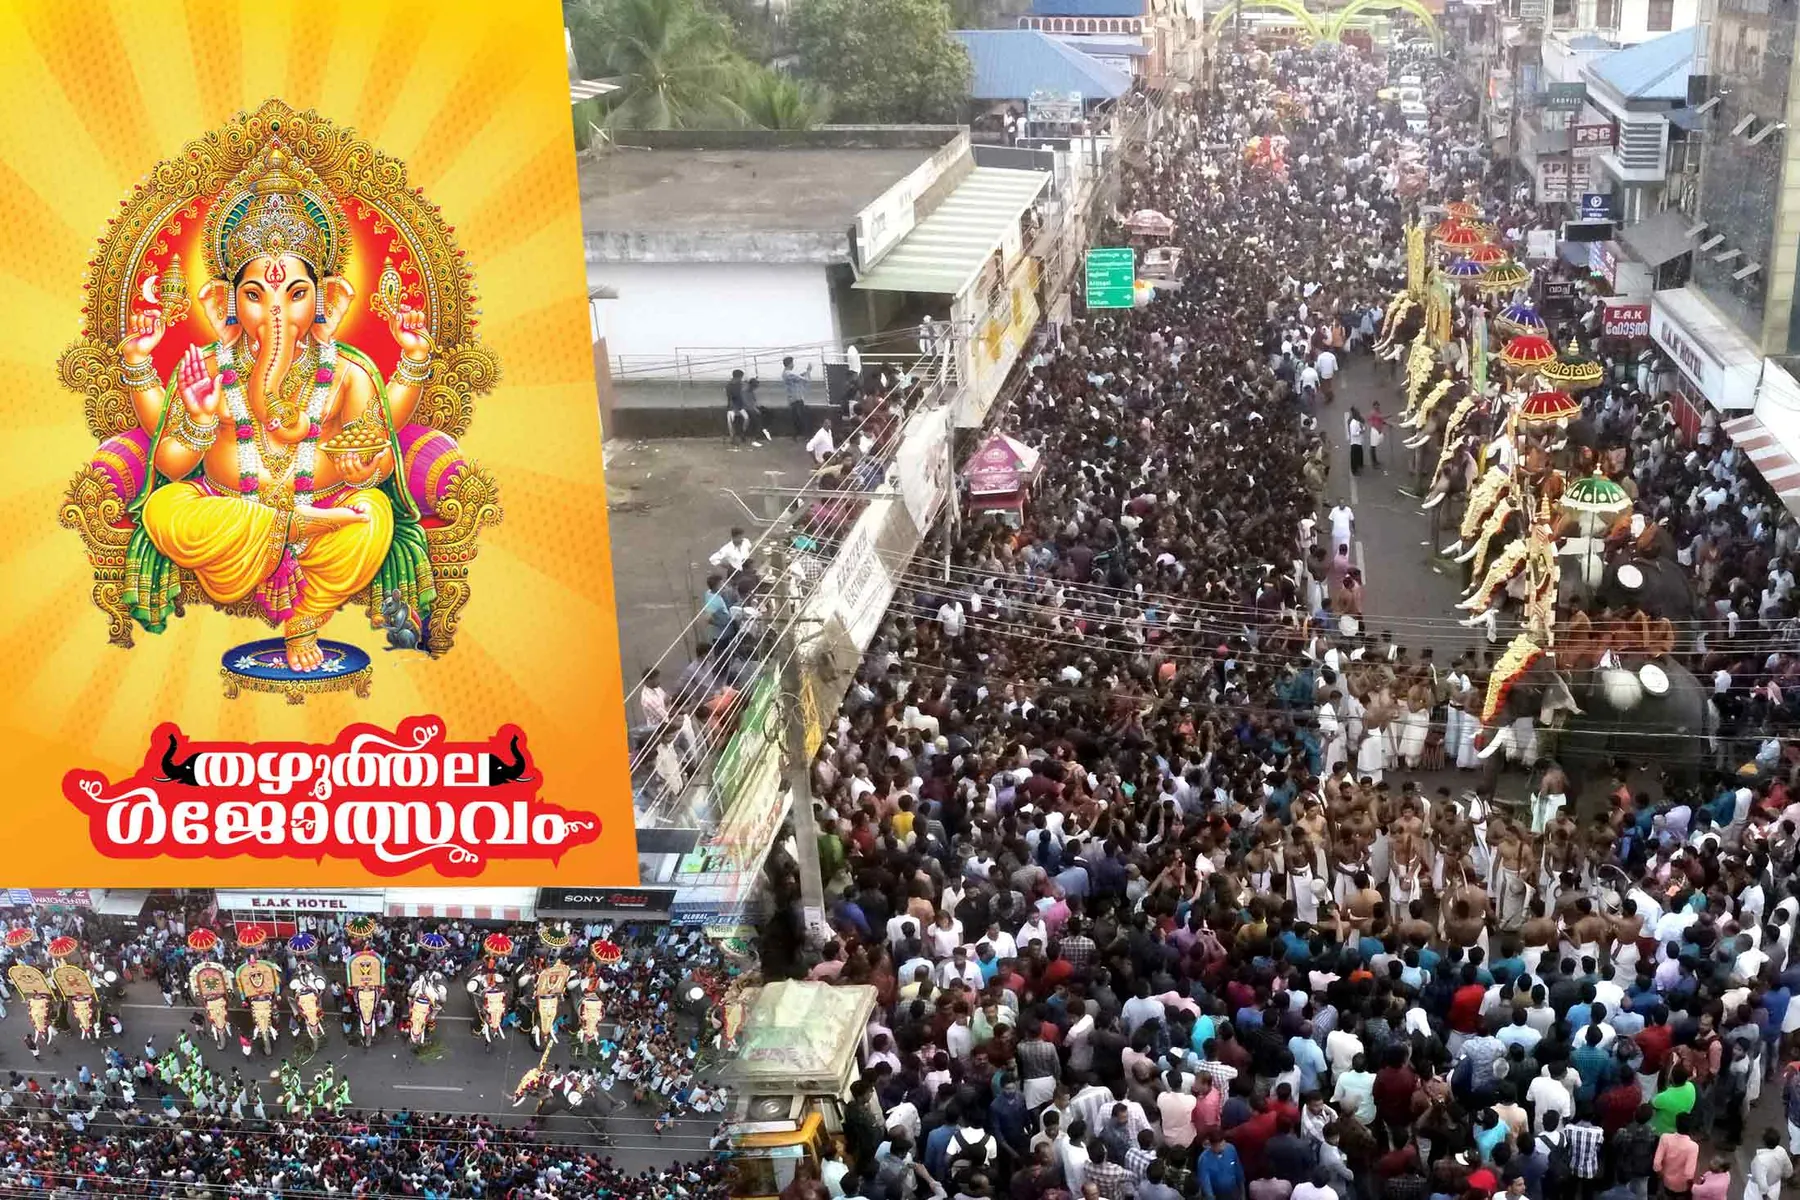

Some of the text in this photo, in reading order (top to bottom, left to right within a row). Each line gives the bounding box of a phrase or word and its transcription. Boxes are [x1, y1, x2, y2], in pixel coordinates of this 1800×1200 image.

[1576, 127, 1611, 142] PSC
[1613, 310, 1642, 320] E.A.K
[251, 898, 347, 909] E.A.K HOTEL
[564, 894, 604, 903] SONY
